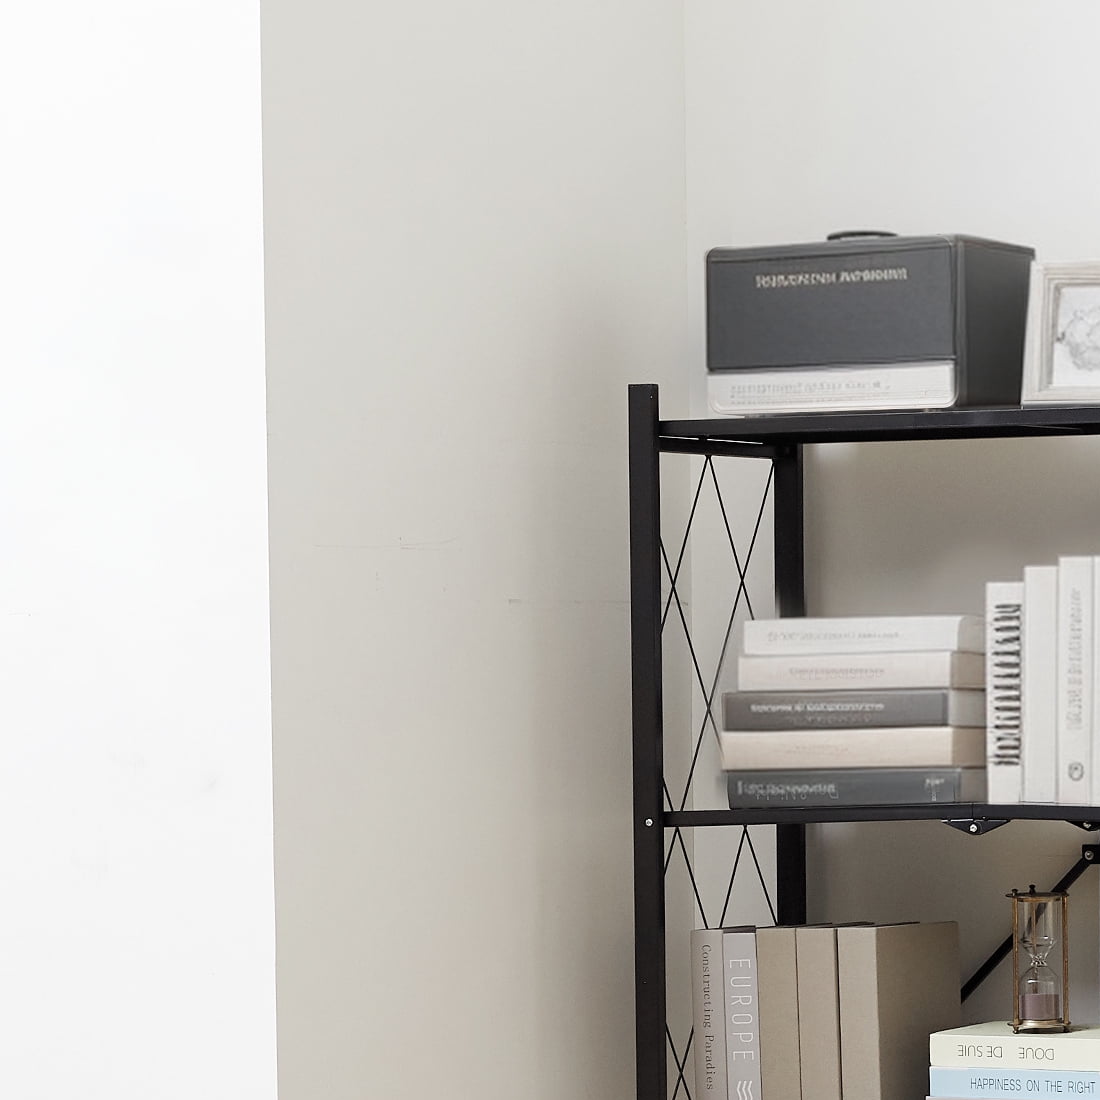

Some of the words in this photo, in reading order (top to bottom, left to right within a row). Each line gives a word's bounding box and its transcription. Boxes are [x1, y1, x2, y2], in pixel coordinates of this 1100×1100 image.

[701, 944, 712, 1030] Constructing
[729, 958, 755, 1061] EUROPE
[705, 1035, 716, 1091] Paradies
[987, 1045, 1003, 1059] DE
[970, 1077, 1022, 1092] HAPPINESS
[1026, 1079, 1040, 1092] ON
[1045, 1080, 1063, 1093] THE
[1067, 1081, 1096, 1094] RIGHT
